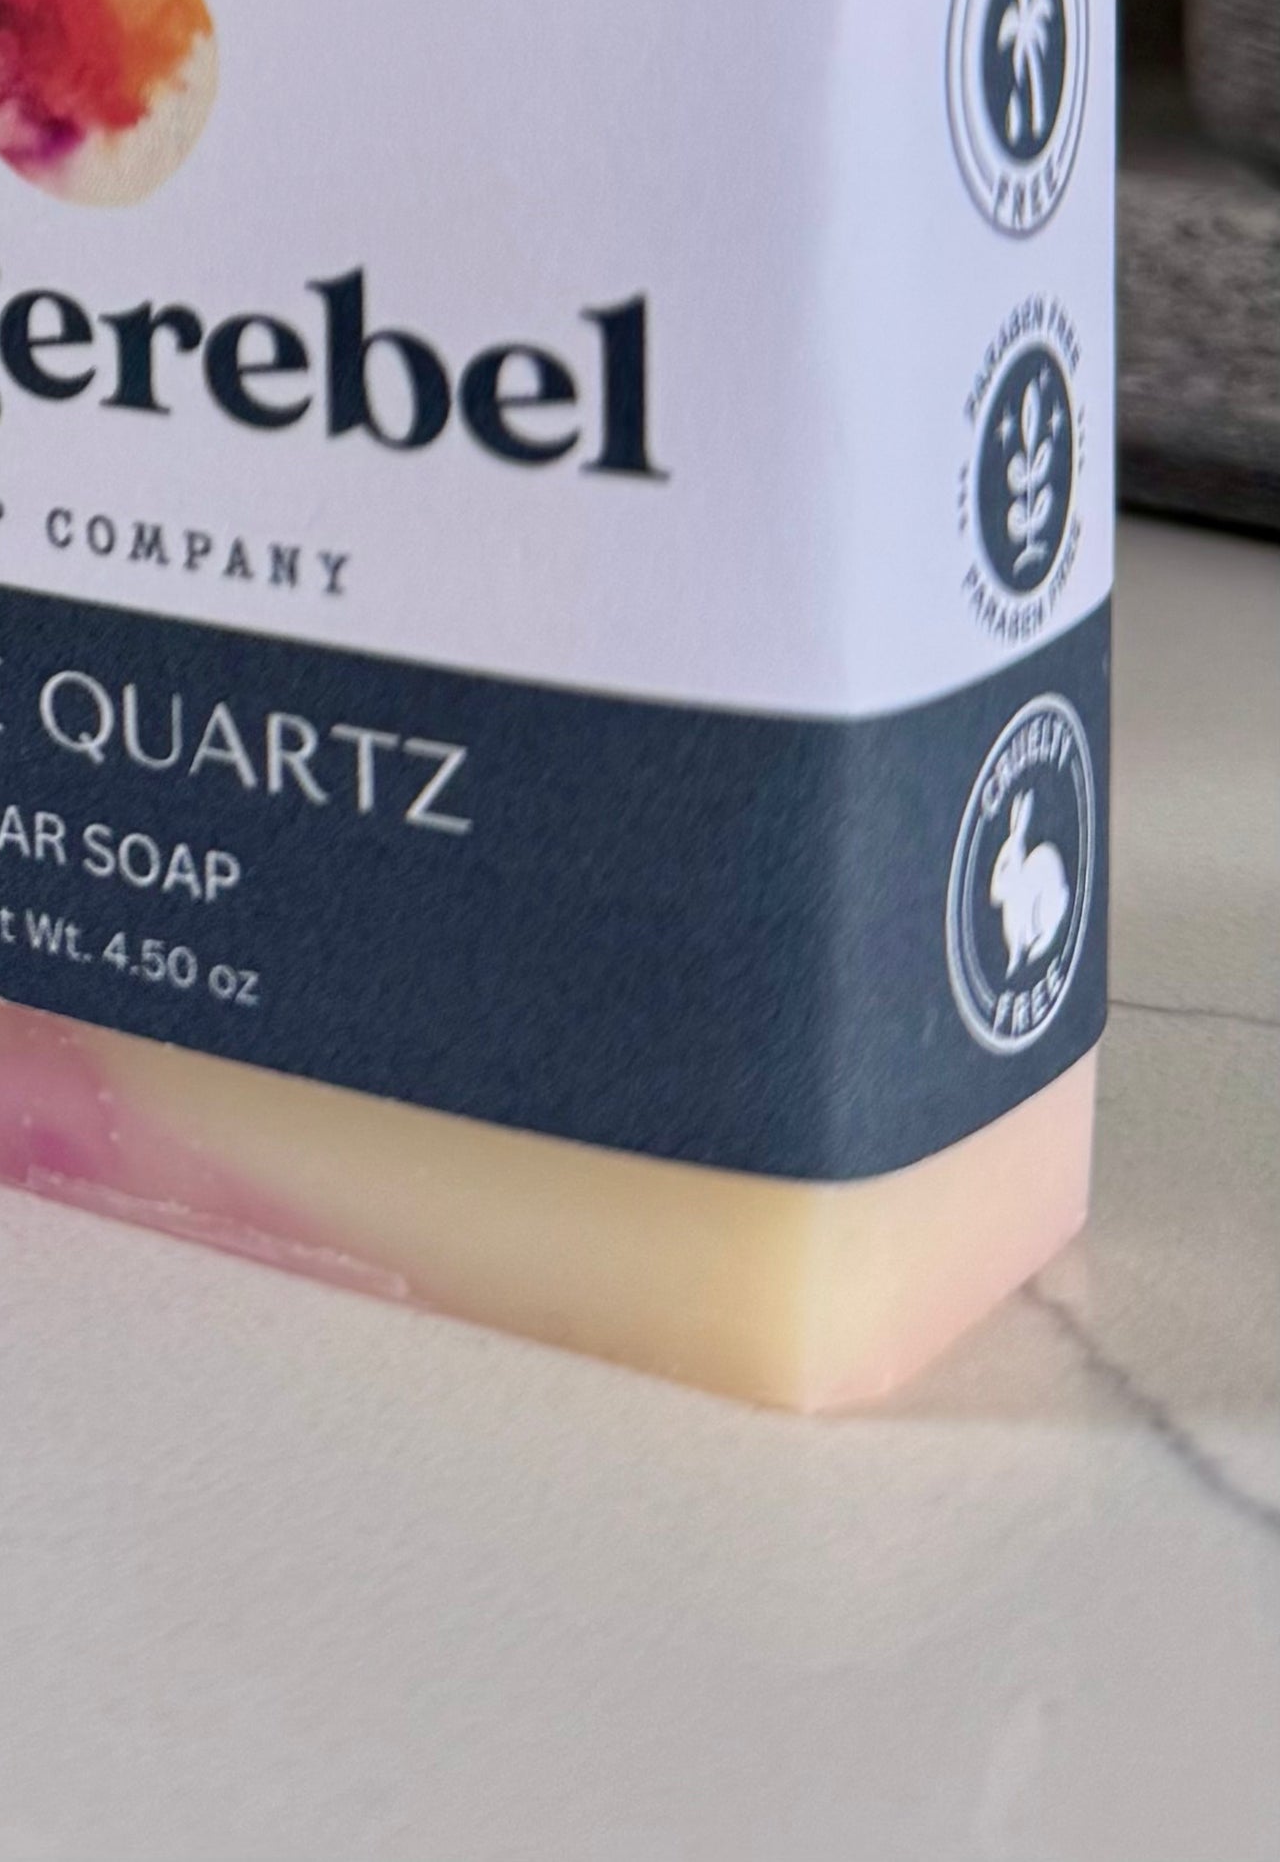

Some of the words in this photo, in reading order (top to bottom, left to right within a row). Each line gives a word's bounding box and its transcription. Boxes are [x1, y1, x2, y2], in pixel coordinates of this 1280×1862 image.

[994, 157, 1058, 229] FREE
[44, 505, 352, 598] COMPANY
[961, 565, 1045, 642] PARABEN
[40, 668, 474, 835] QUARTZ
[982, 713, 1073, 819] CRUELTY
[82, 821, 241, 902] SOAP
[24, 906, 93, 965] Wt.
[101, 928, 199, 991] 4.50
[207, 964, 261, 1006] oz
[993, 955, 1065, 1038] FREE
